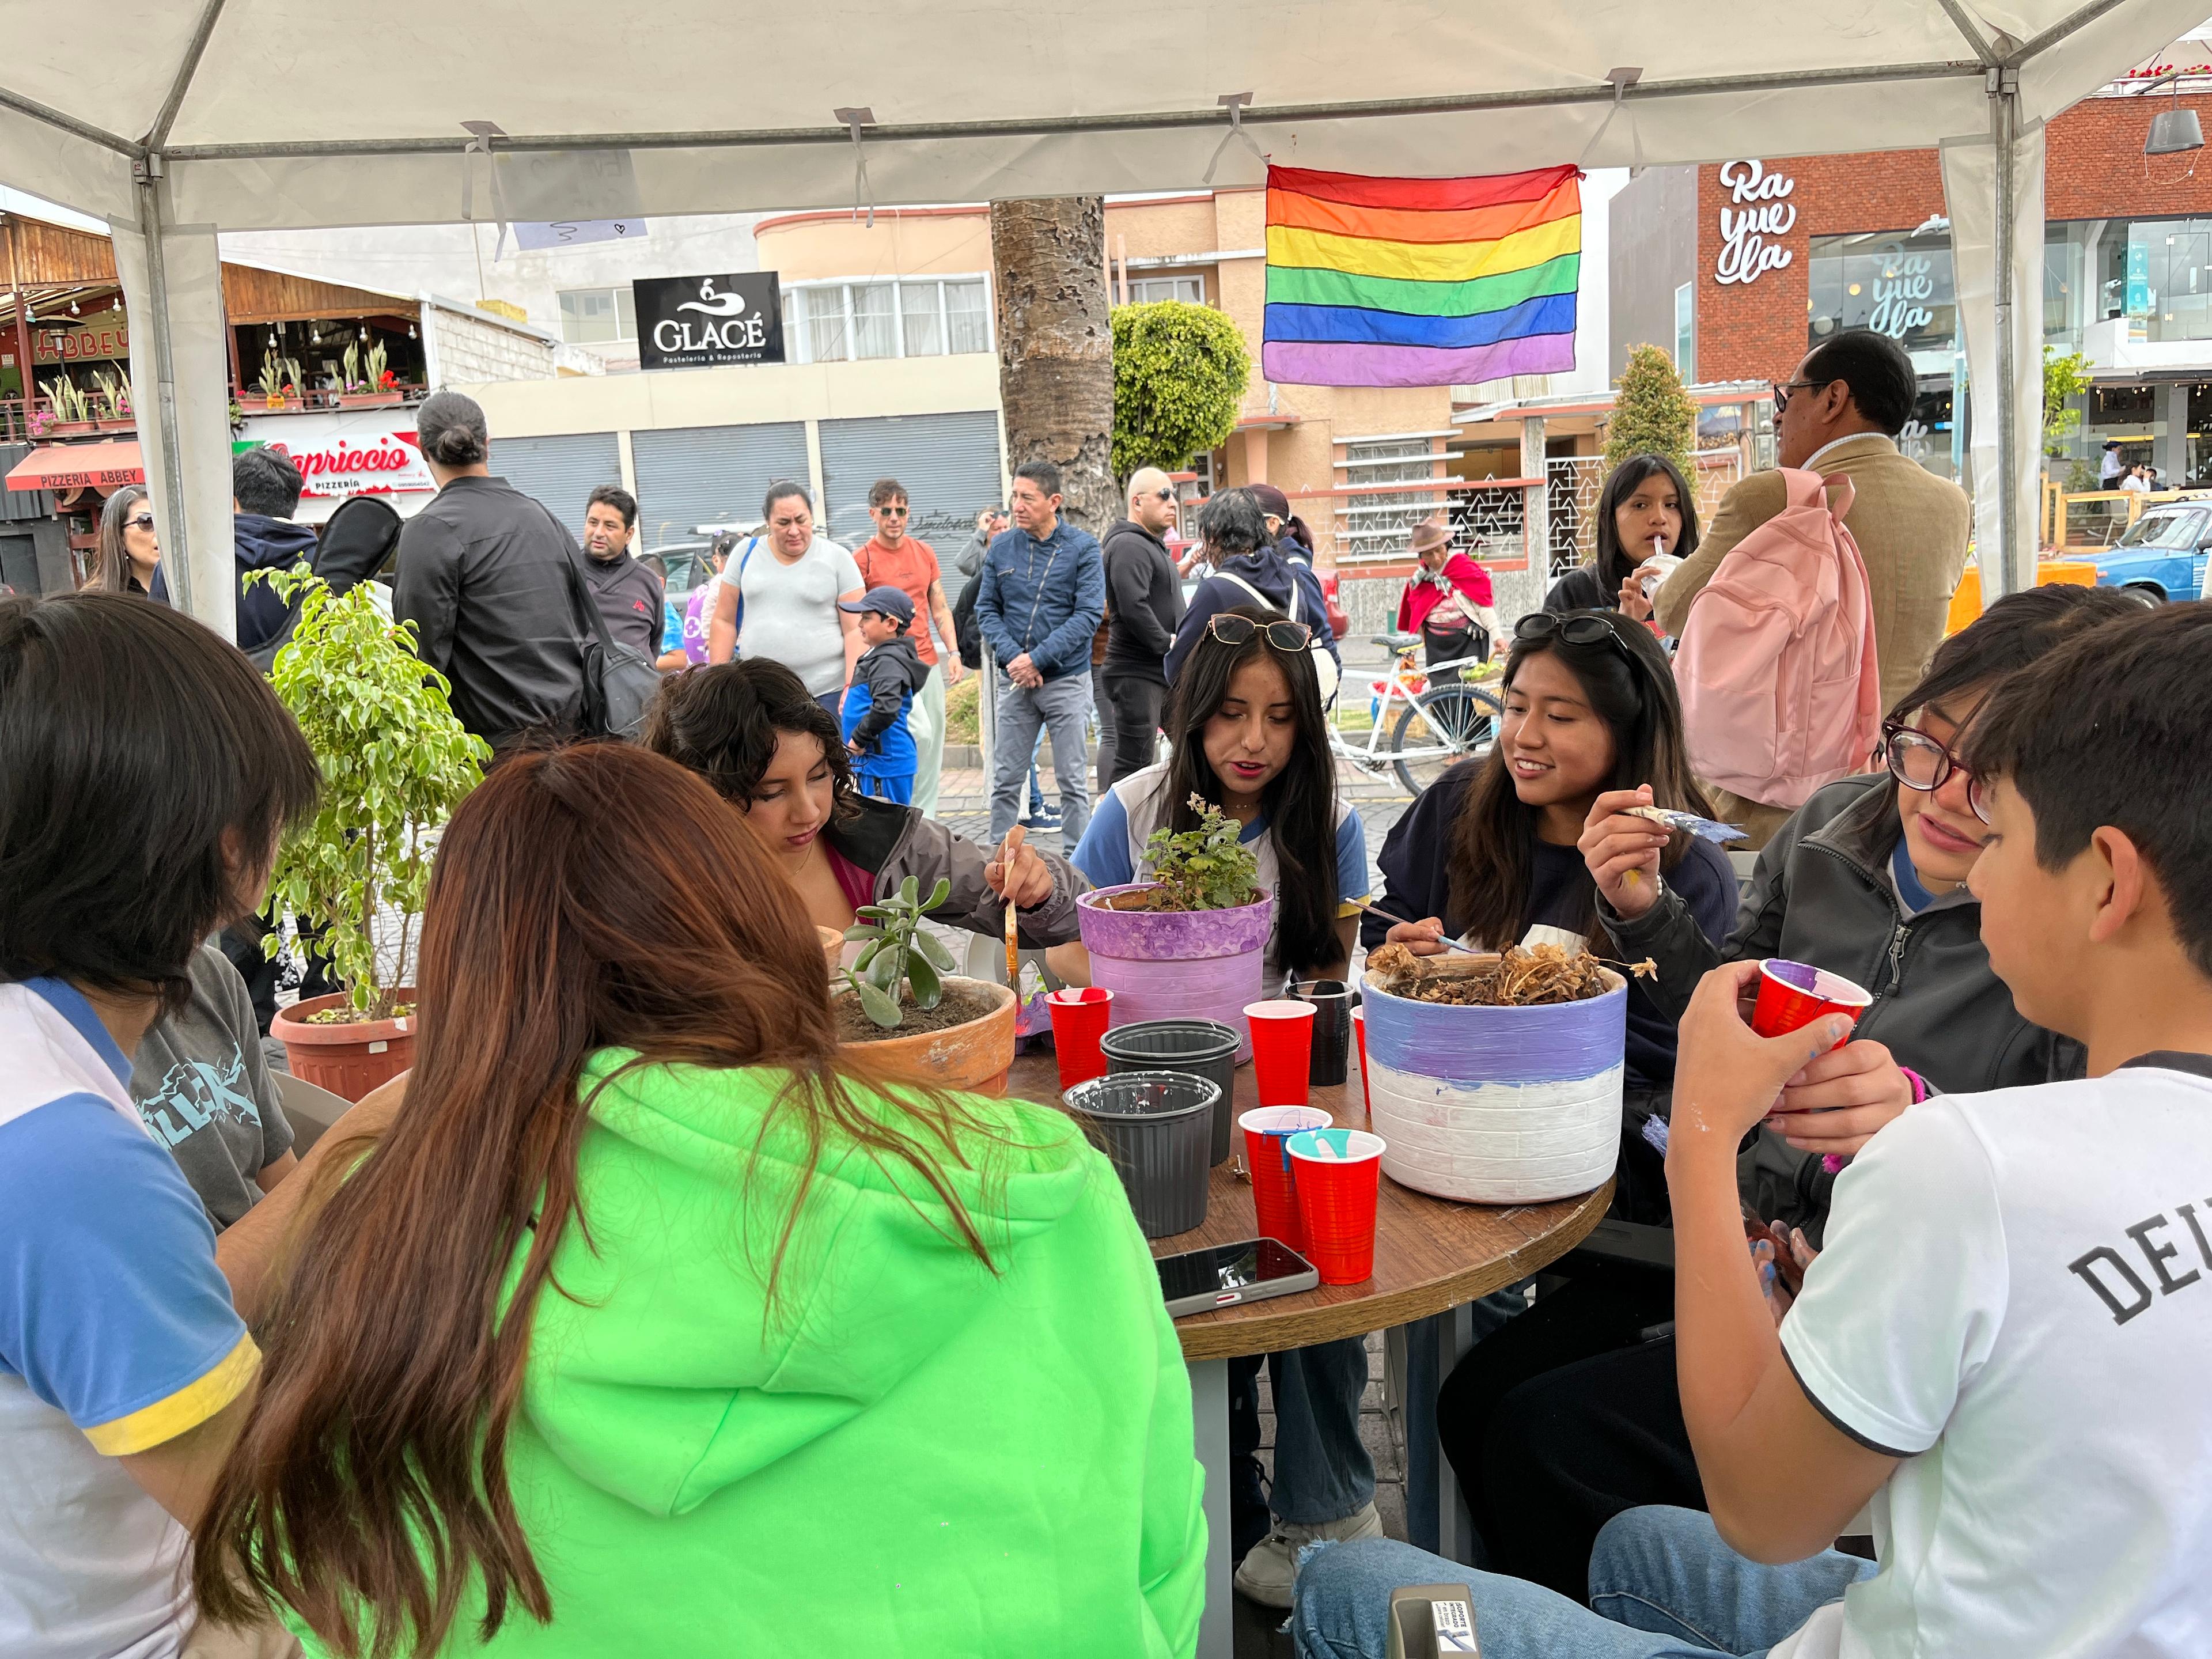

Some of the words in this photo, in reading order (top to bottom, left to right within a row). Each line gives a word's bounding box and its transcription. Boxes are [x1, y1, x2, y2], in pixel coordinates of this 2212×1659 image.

[1719, 160, 1794, 203] Ra
[1715, 235, 1792, 284] la
[1717, 203, 1796, 276] yue
[1873, 240, 1930, 278] Ra
[1869, 275, 1933, 332] yue
[1884, 300, 1933, 339] la
[654, 312, 766, 352] GLACÉ
[41, 473, 92, 487] PIZZERIA
[101, 470, 137, 483] ABBEY
